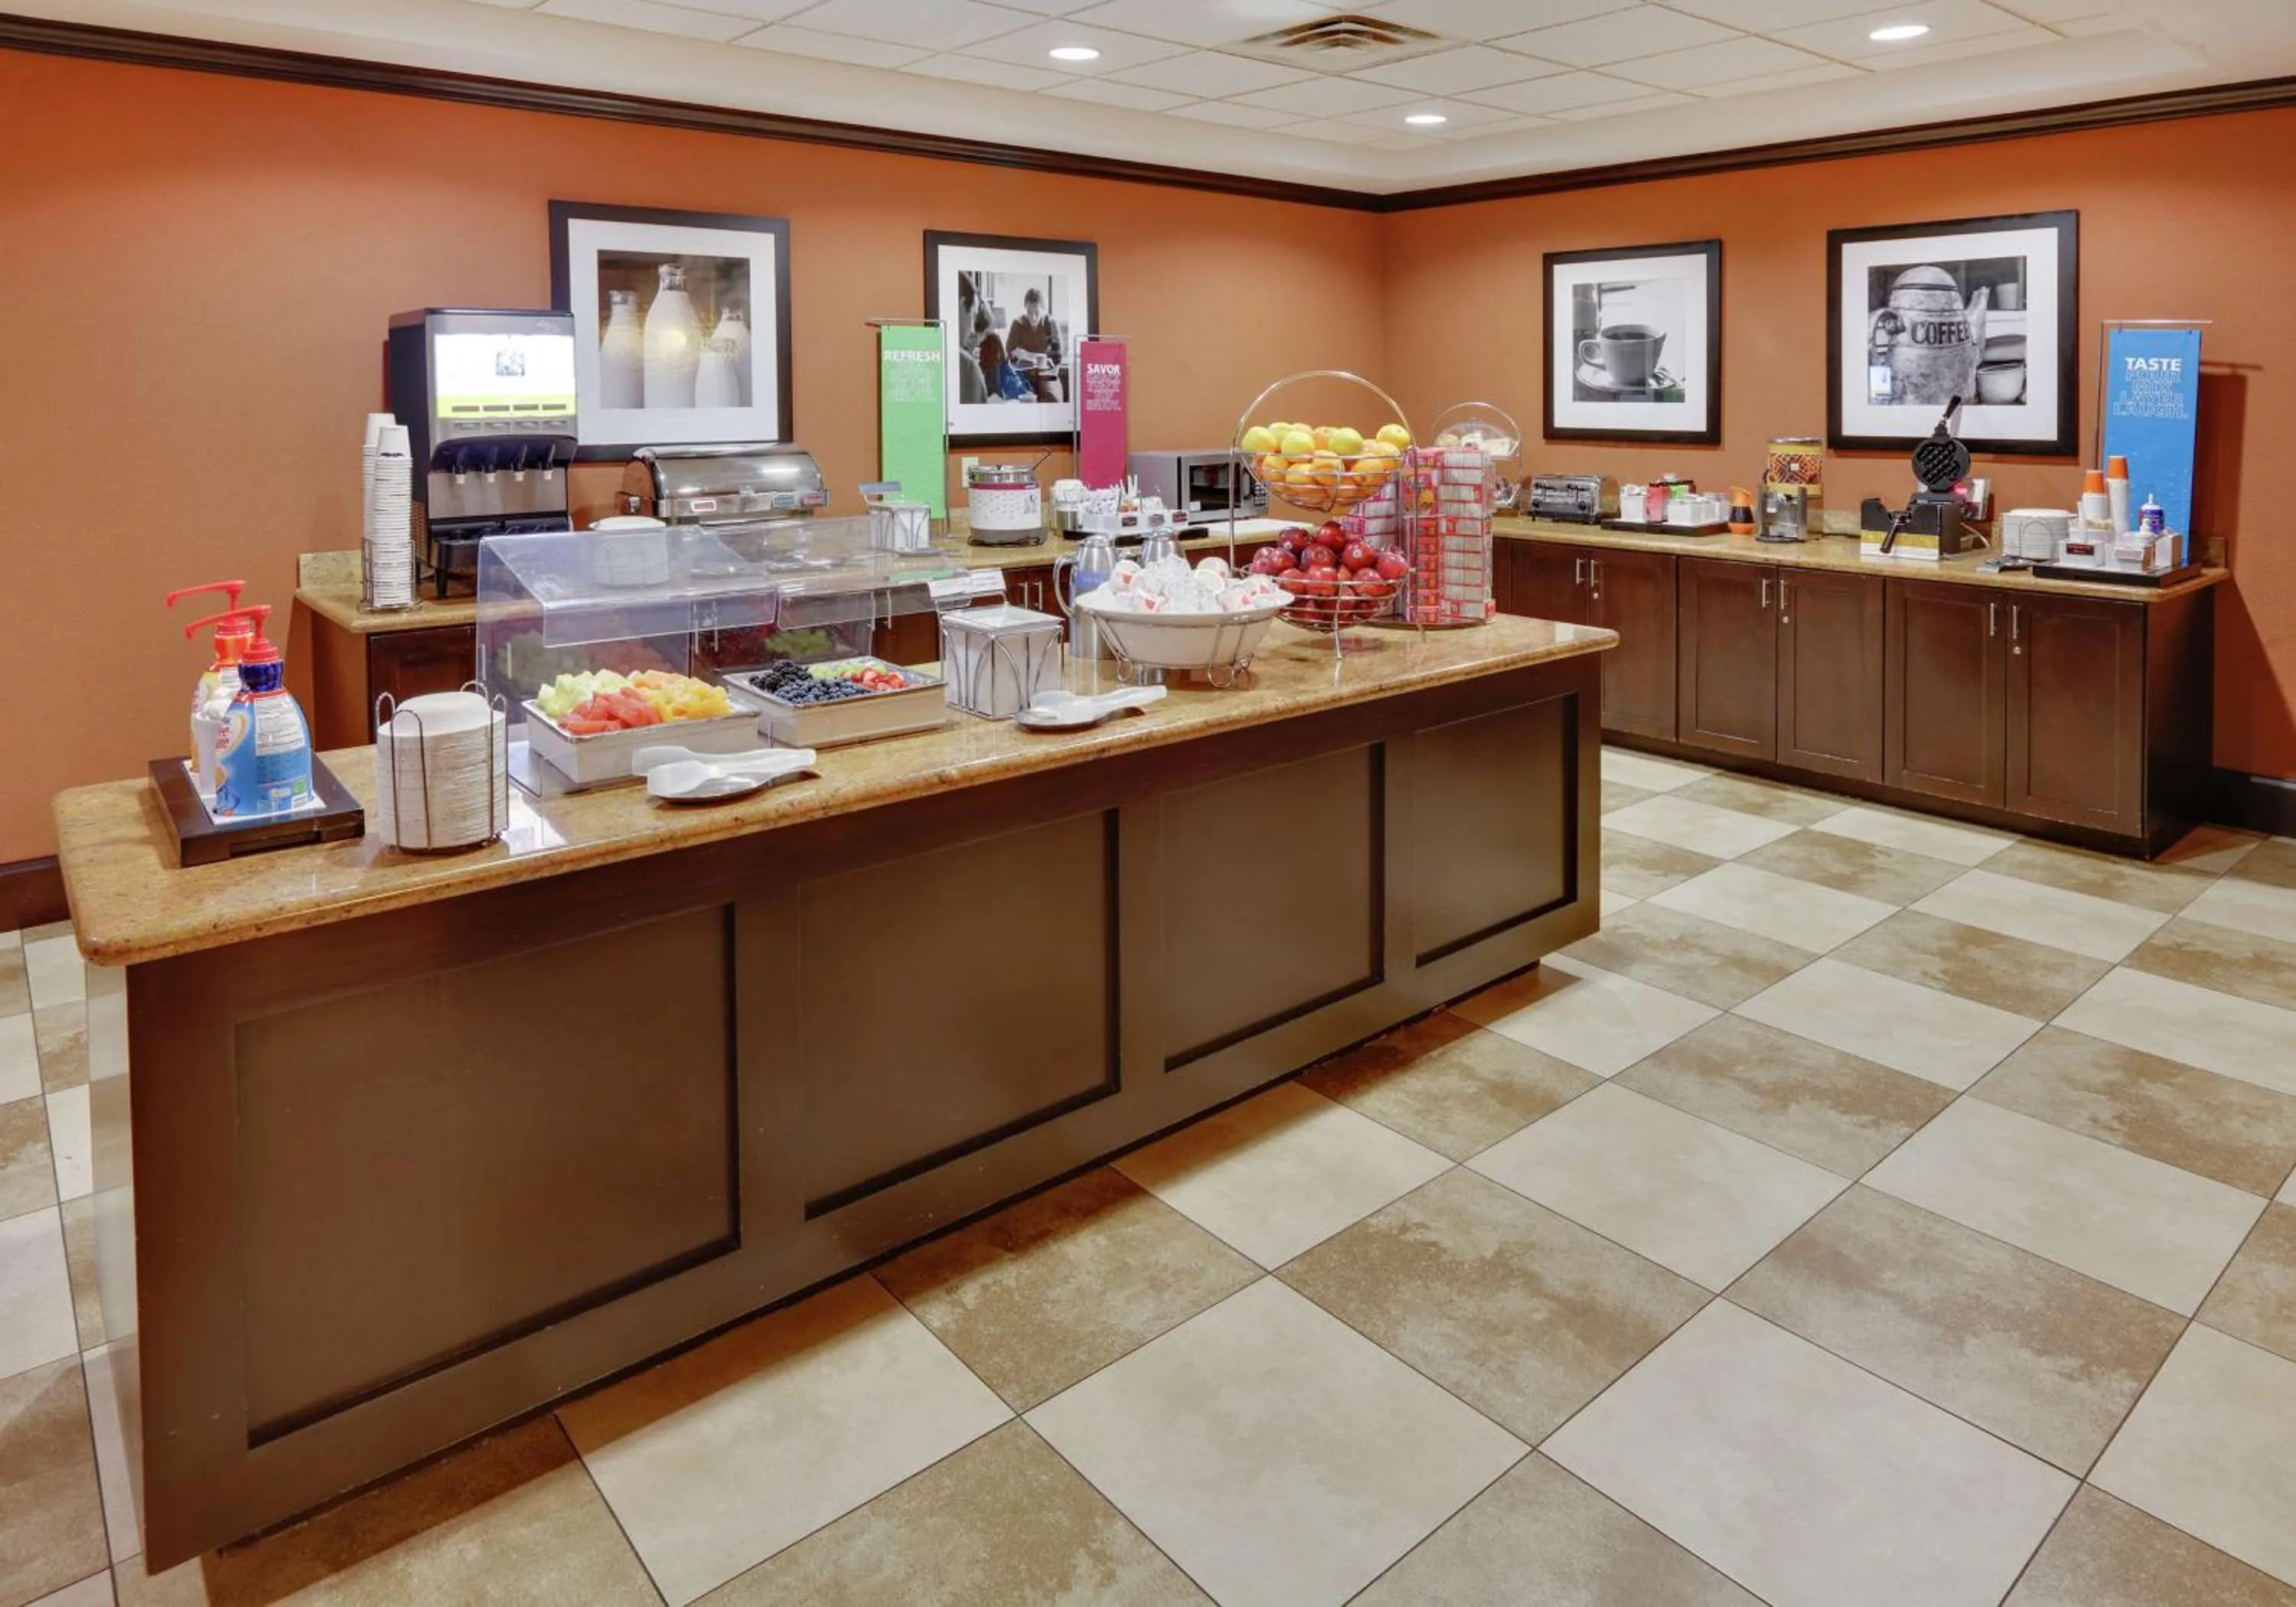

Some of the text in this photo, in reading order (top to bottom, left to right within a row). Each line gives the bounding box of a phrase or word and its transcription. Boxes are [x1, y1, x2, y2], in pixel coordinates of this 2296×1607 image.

[1912, 321, 1969, 344] COFFEE
[884, 350, 940, 362] REFRESH
[1087, 363, 1120, 374] SAVOR
[2125, 357, 2182, 371] TASTE
